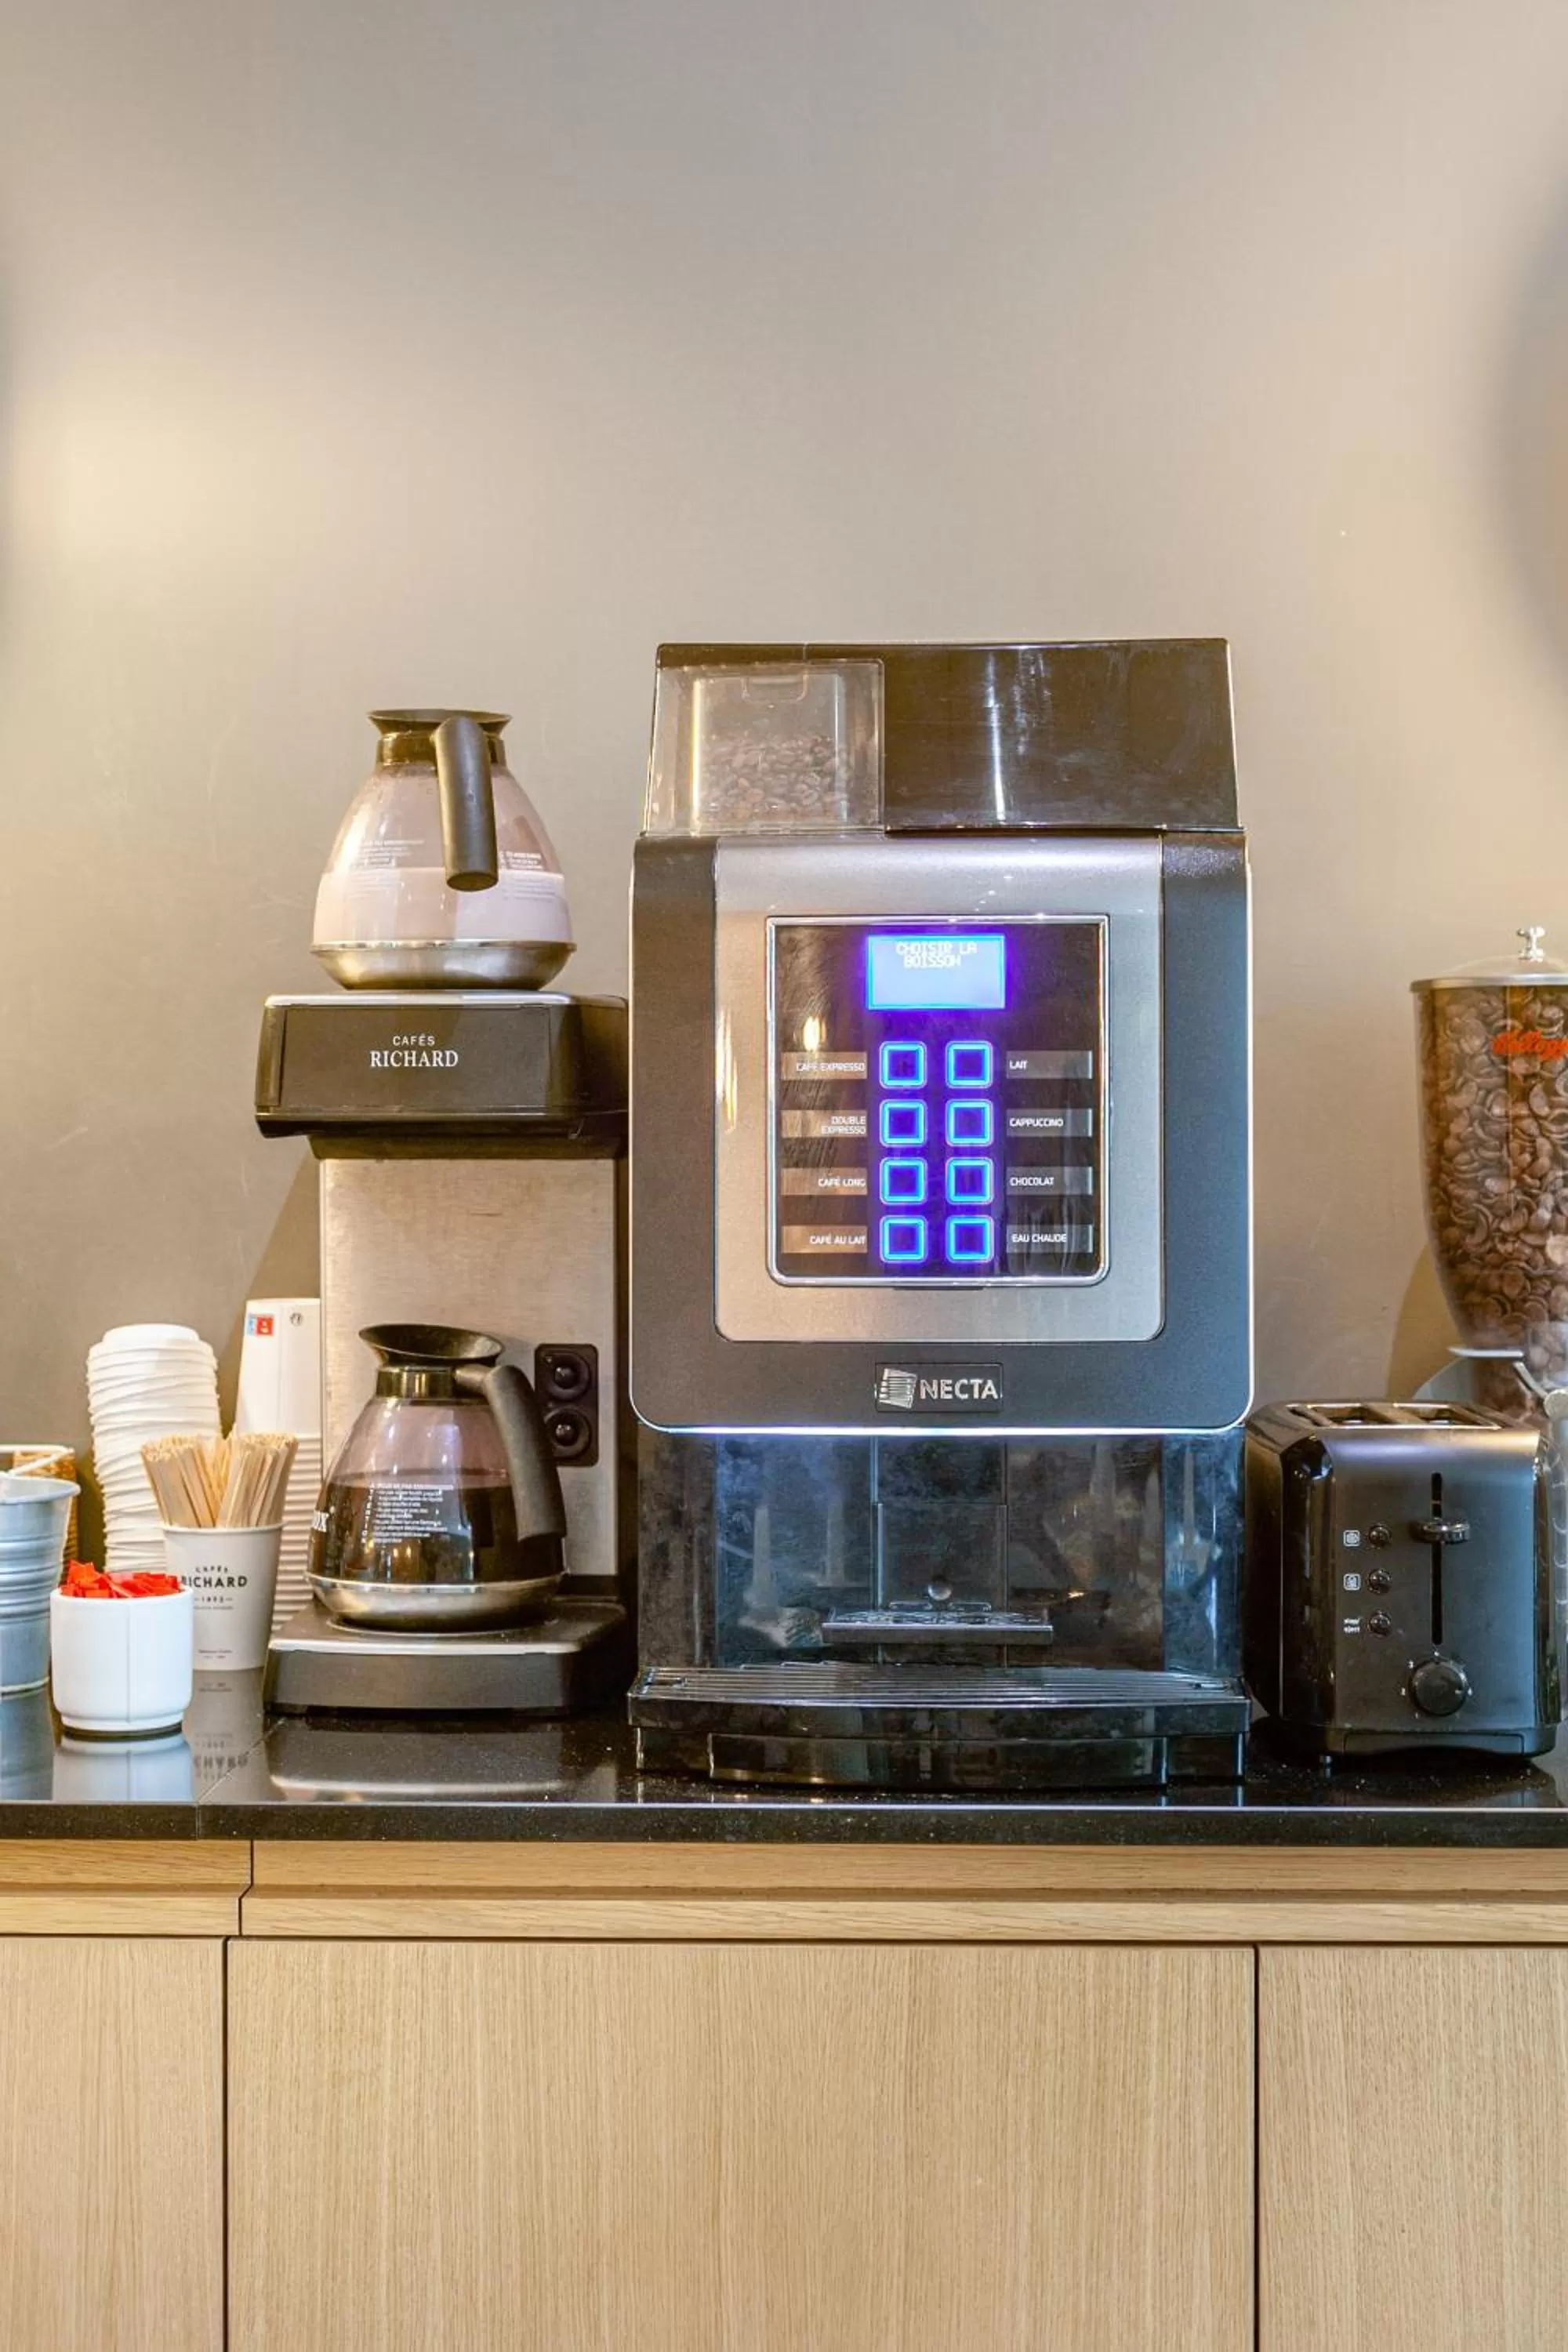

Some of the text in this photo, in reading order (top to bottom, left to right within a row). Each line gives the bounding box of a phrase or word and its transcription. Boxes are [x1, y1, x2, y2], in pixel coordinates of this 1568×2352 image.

[960, 942, 978, 954] LA
[393, 1033, 435, 1046] CAFÉS
[369, 1050, 459, 1067] RICHARD
[1009, 1059, 1028, 1070] LAIT
[831, 1116, 866, 1125] DOUBLE
[1009, 1117, 1064, 1127] CAPPUCCINO
[843, 1178, 866, 1187] LONG
[1009, 1177, 1054, 1186] CHOCOLAT
[833, 1235, 847, 1245] AU
[848, 1235, 866, 1245] LAIT
[1011, 1233, 1067, 1243] EAU CHAUDE
[920, 1379, 999, 1399] NECTA
[181, 1575, 249, 1588] RICHARD
